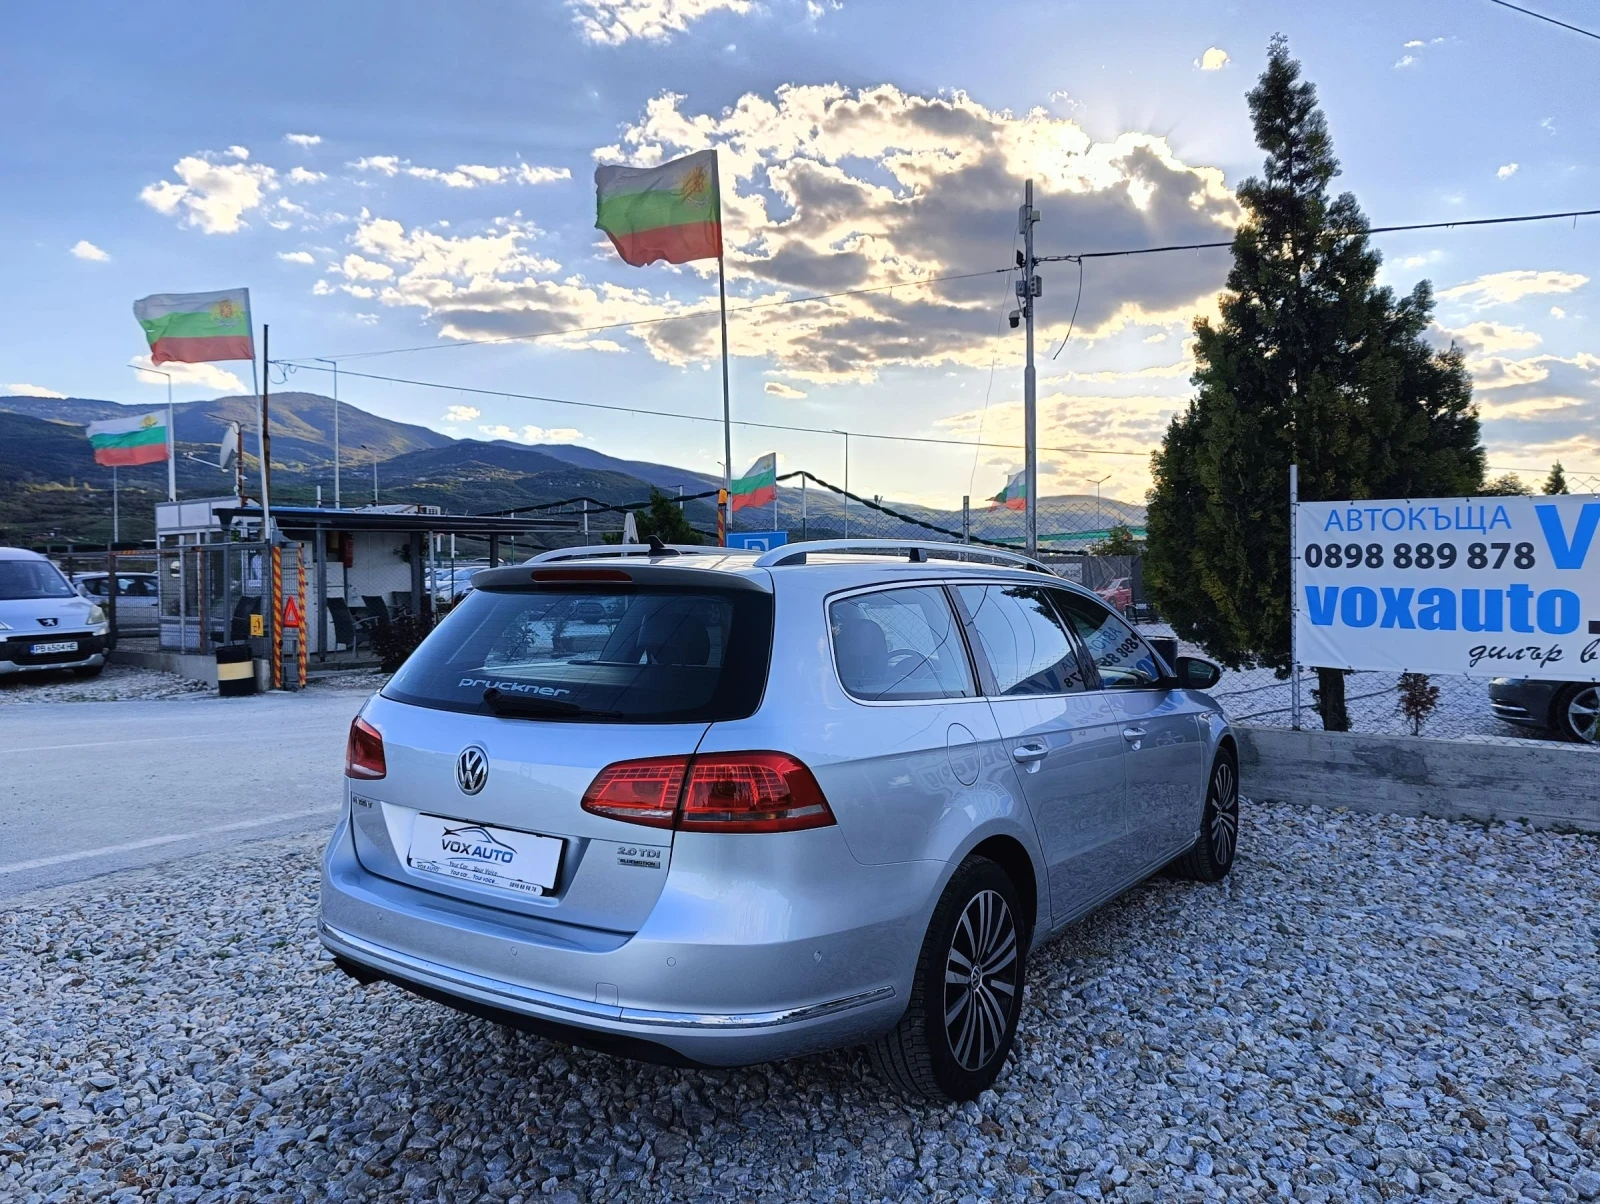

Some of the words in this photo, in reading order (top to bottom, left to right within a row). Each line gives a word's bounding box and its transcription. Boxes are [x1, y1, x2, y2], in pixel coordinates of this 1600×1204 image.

[1324, 505, 1512, 535] АВТОКЪЩА
[1305, 543, 1384, 569] 0898
[1393, 543, 1457, 570] 889
[1467, 542, 1536, 570] 878
[1469, 644, 1564, 668] дилър
[458, 678, 571, 697] pruckner
[617, 846, 637, 856] 2.0
[639, 848, 661, 859] TDI
